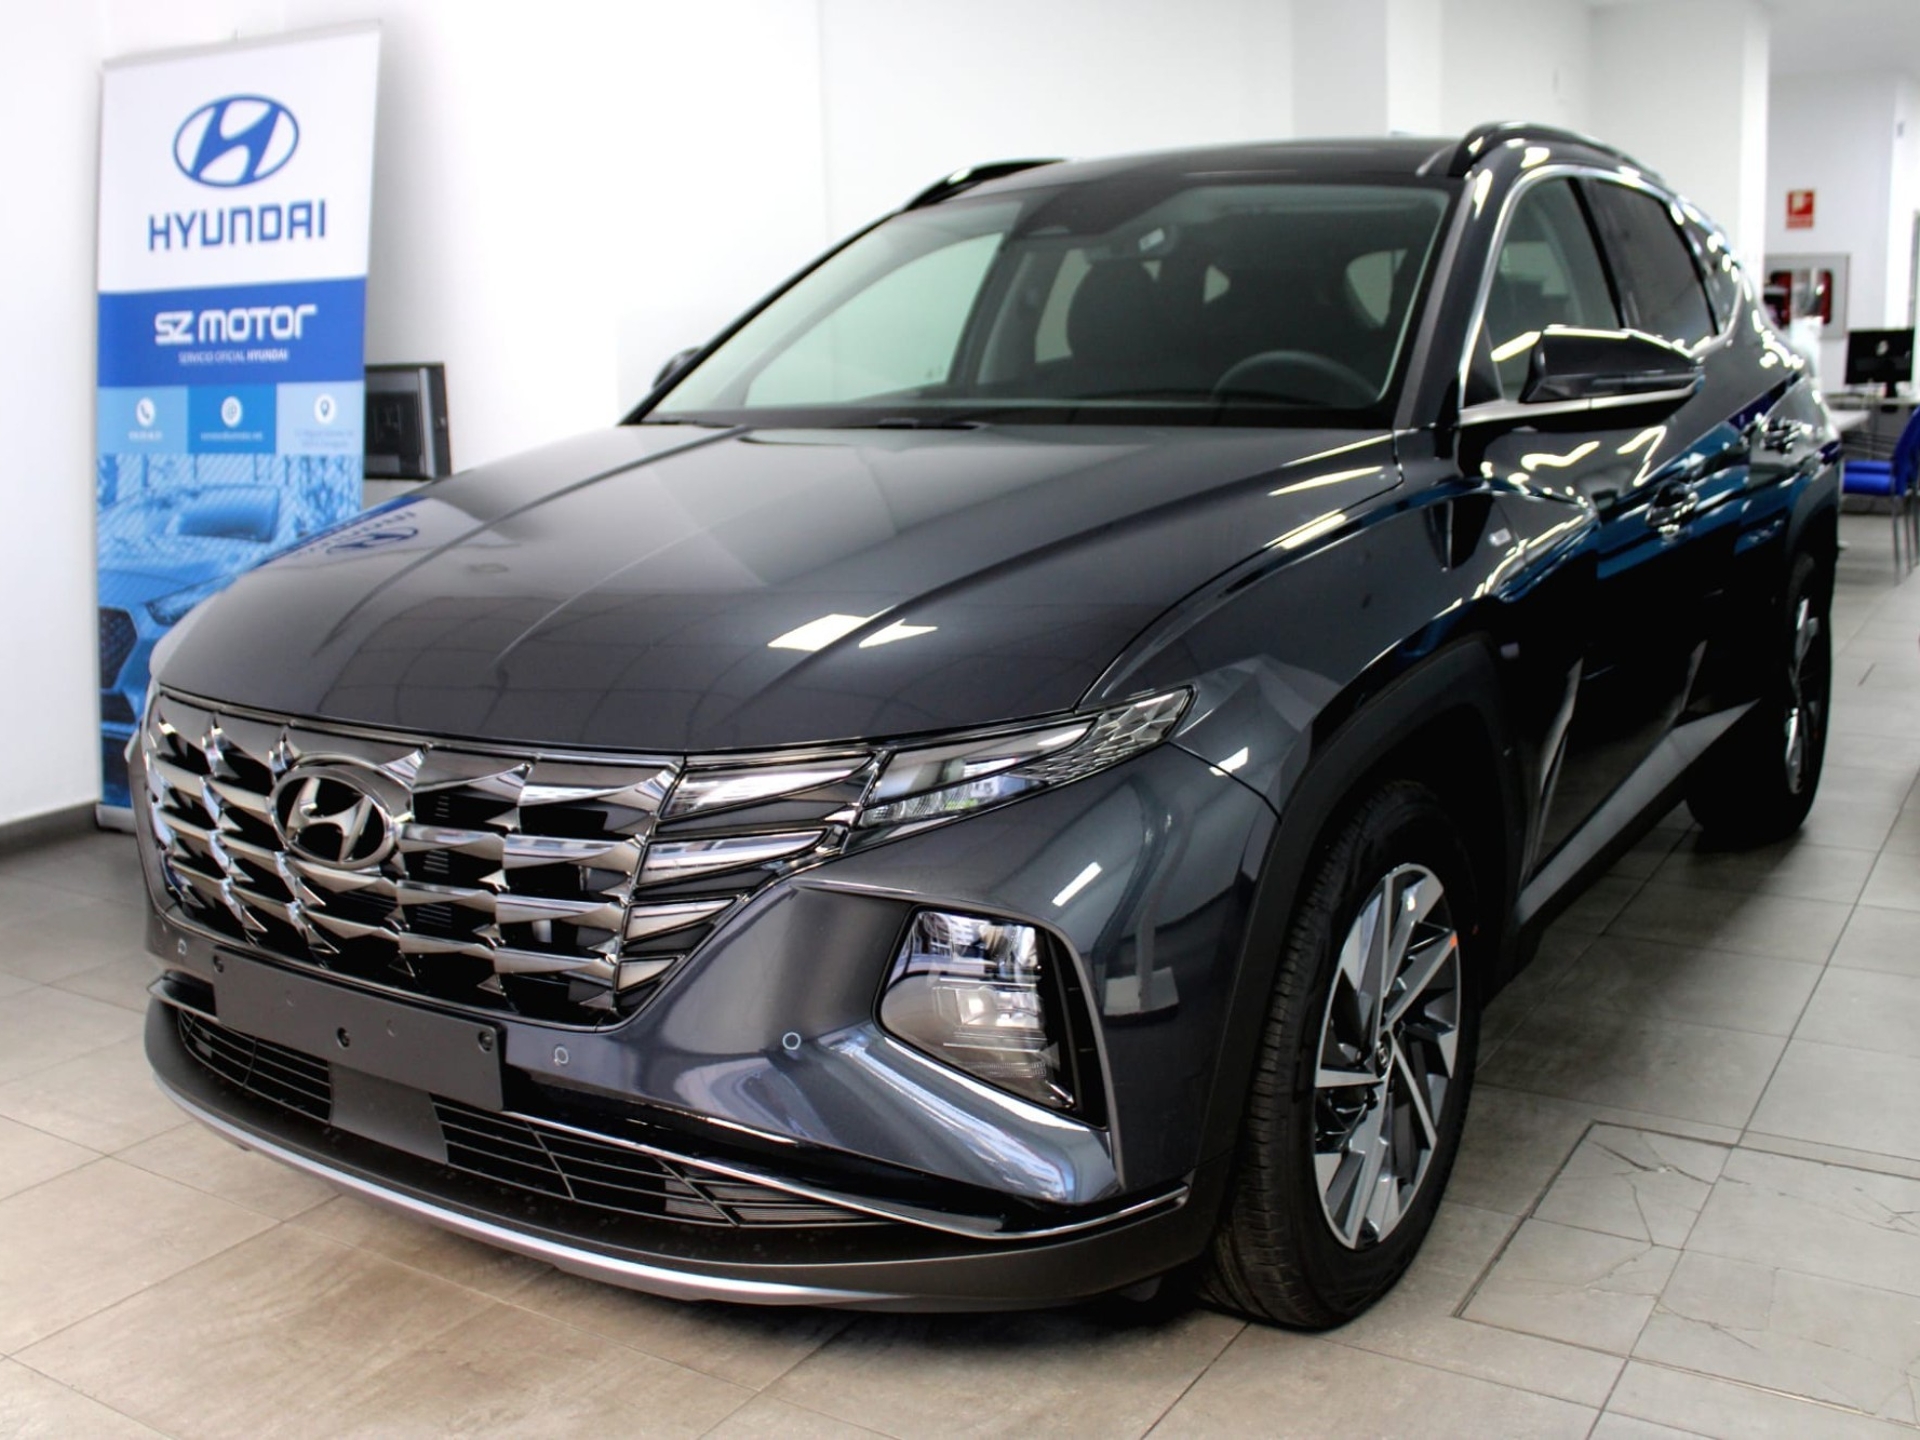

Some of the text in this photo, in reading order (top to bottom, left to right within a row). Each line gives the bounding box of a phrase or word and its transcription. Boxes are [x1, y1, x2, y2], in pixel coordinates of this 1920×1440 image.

[148, 198, 326, 251] HYUNDAI
[154, 310, 194, 346] SZ
[246, 348, 289, 362] HYUNDAI
